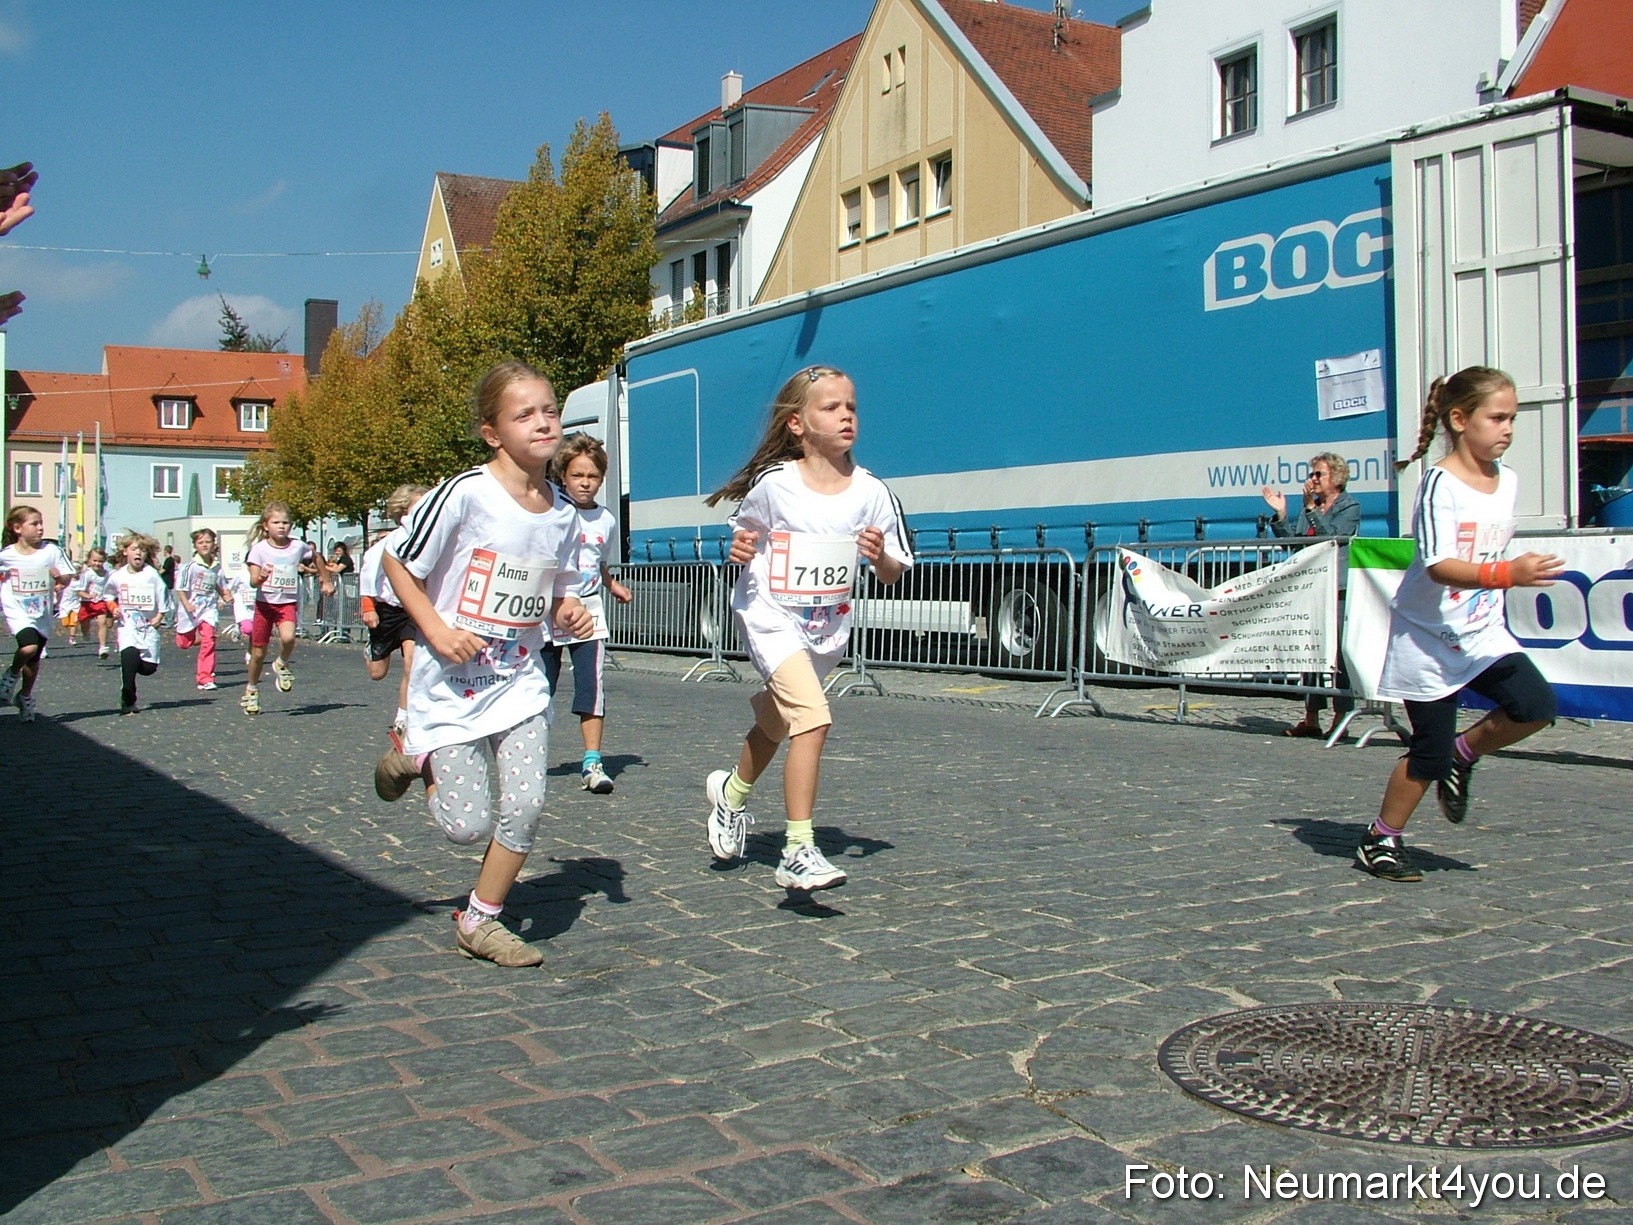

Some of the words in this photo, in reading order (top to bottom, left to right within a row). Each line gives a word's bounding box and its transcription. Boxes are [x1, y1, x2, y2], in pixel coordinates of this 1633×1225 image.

[1333, 395, 1368, 411] BOCK
[497, 562, 529, 581] Anna
[794, 565, 848, 586] 7182
[21, 580, 47, 590] 7174
[274, 577, 296, 586] 7089
[1267, 585, 1299, 596] ALLER
[130, 594, 153, 604] 7195
[493, 591, 546, 618] 7099
[1162, 640, 1196, 648] STRASSE
[1199, 640, 1206, 648] 3
[1233, 645, 1270, 654] EINLAGEN
[1273, 643, 1301, 652] ALLER
[1304, 643, 1321, 652] ART
